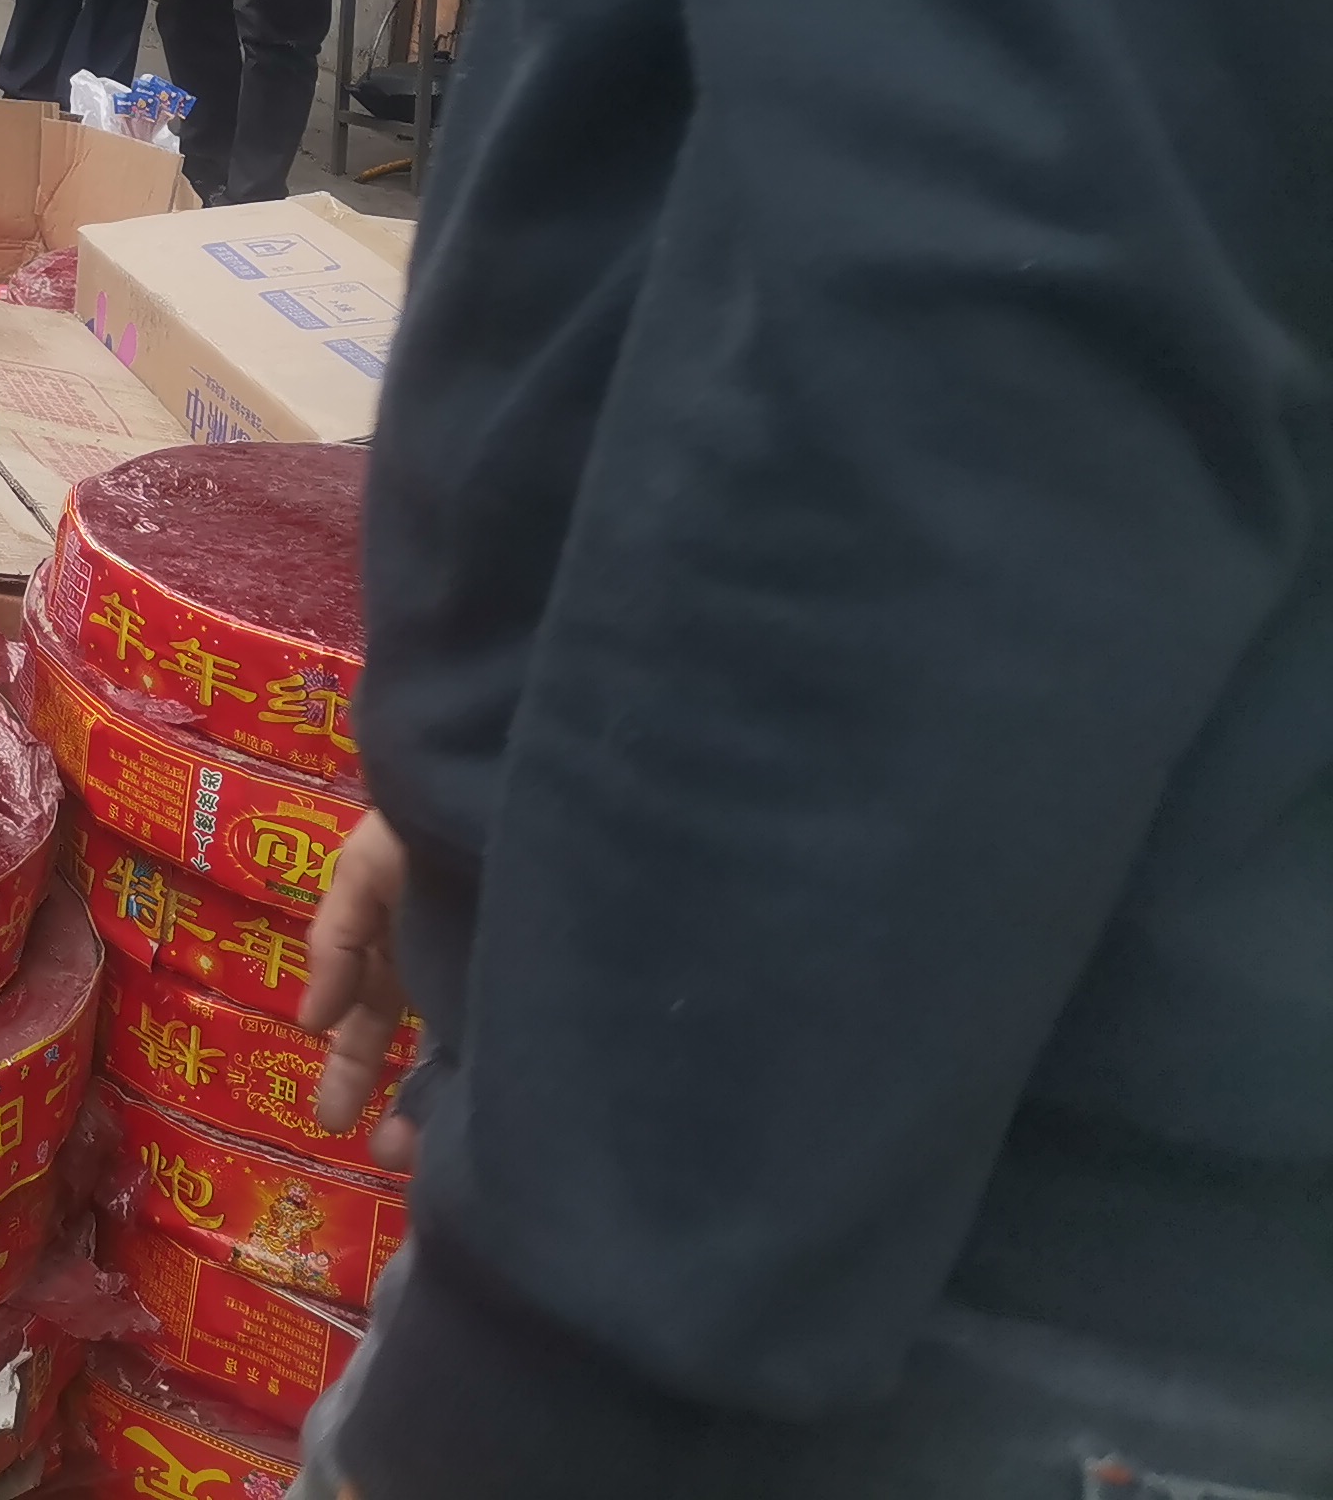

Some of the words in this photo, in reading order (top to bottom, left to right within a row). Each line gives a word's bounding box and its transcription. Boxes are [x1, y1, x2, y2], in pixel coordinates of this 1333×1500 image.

[89, 592, 361, 754] 年年红
[192, 767, 223, 872] 个人燃放类
[140, 1141, 225, 1230] 炮
[223, 1356, 282, 1397] 警示语
